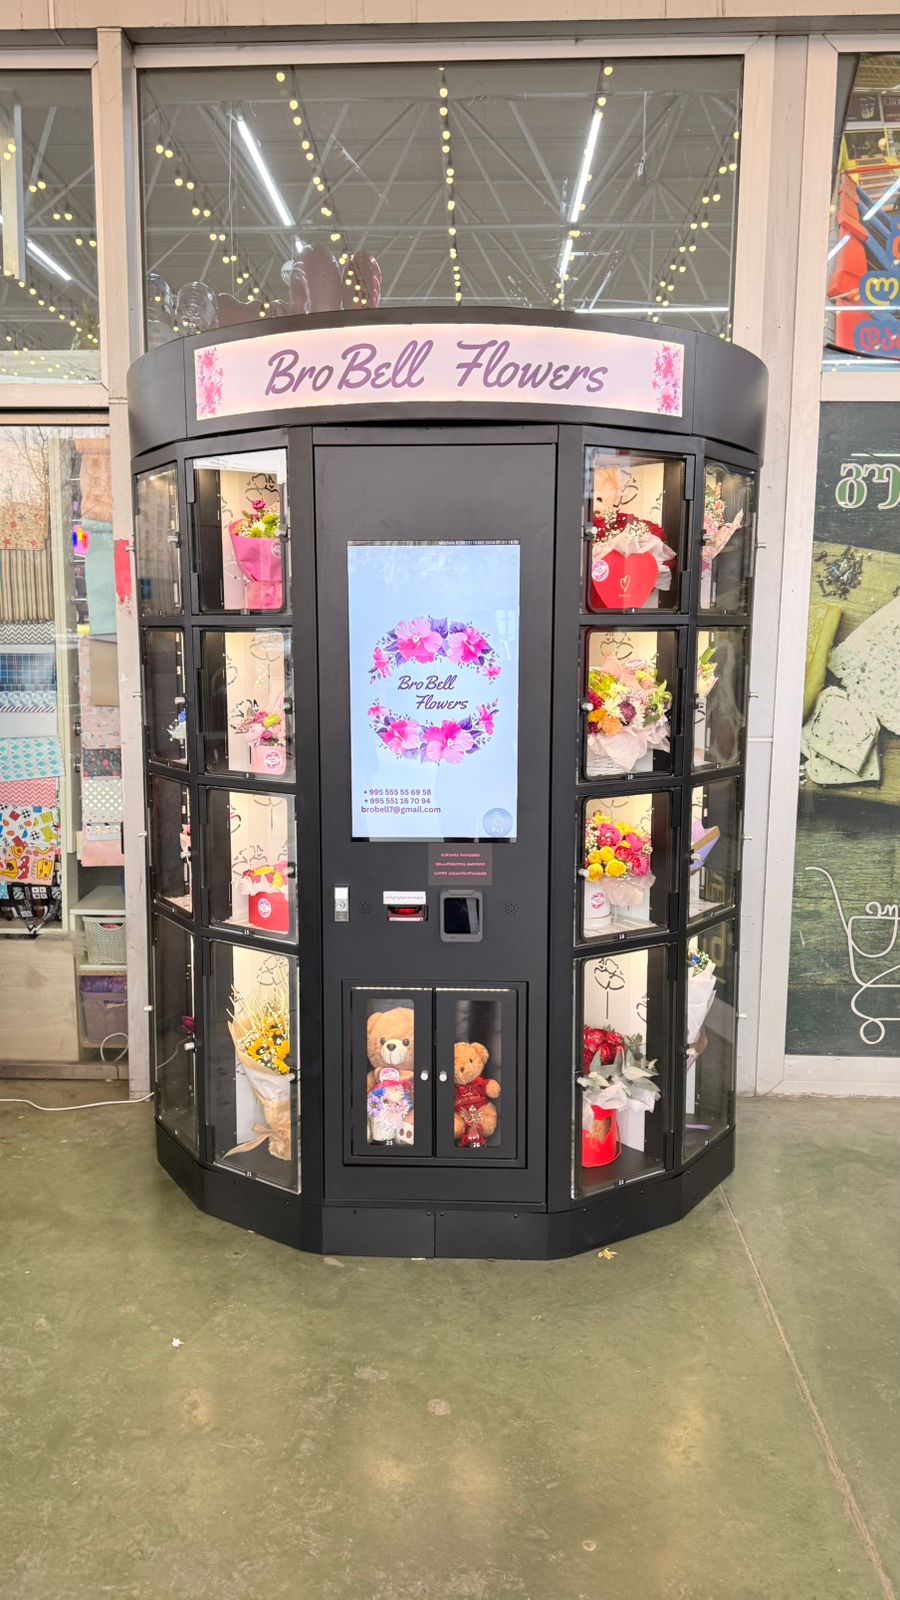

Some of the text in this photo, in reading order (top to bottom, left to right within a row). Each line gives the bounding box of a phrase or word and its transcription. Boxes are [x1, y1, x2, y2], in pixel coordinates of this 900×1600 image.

[455, 339, 608, 393] Flowers
[416, 694, 469, 710] Flowers
[361, 806, 441, 815] brobell7@gmail.com
